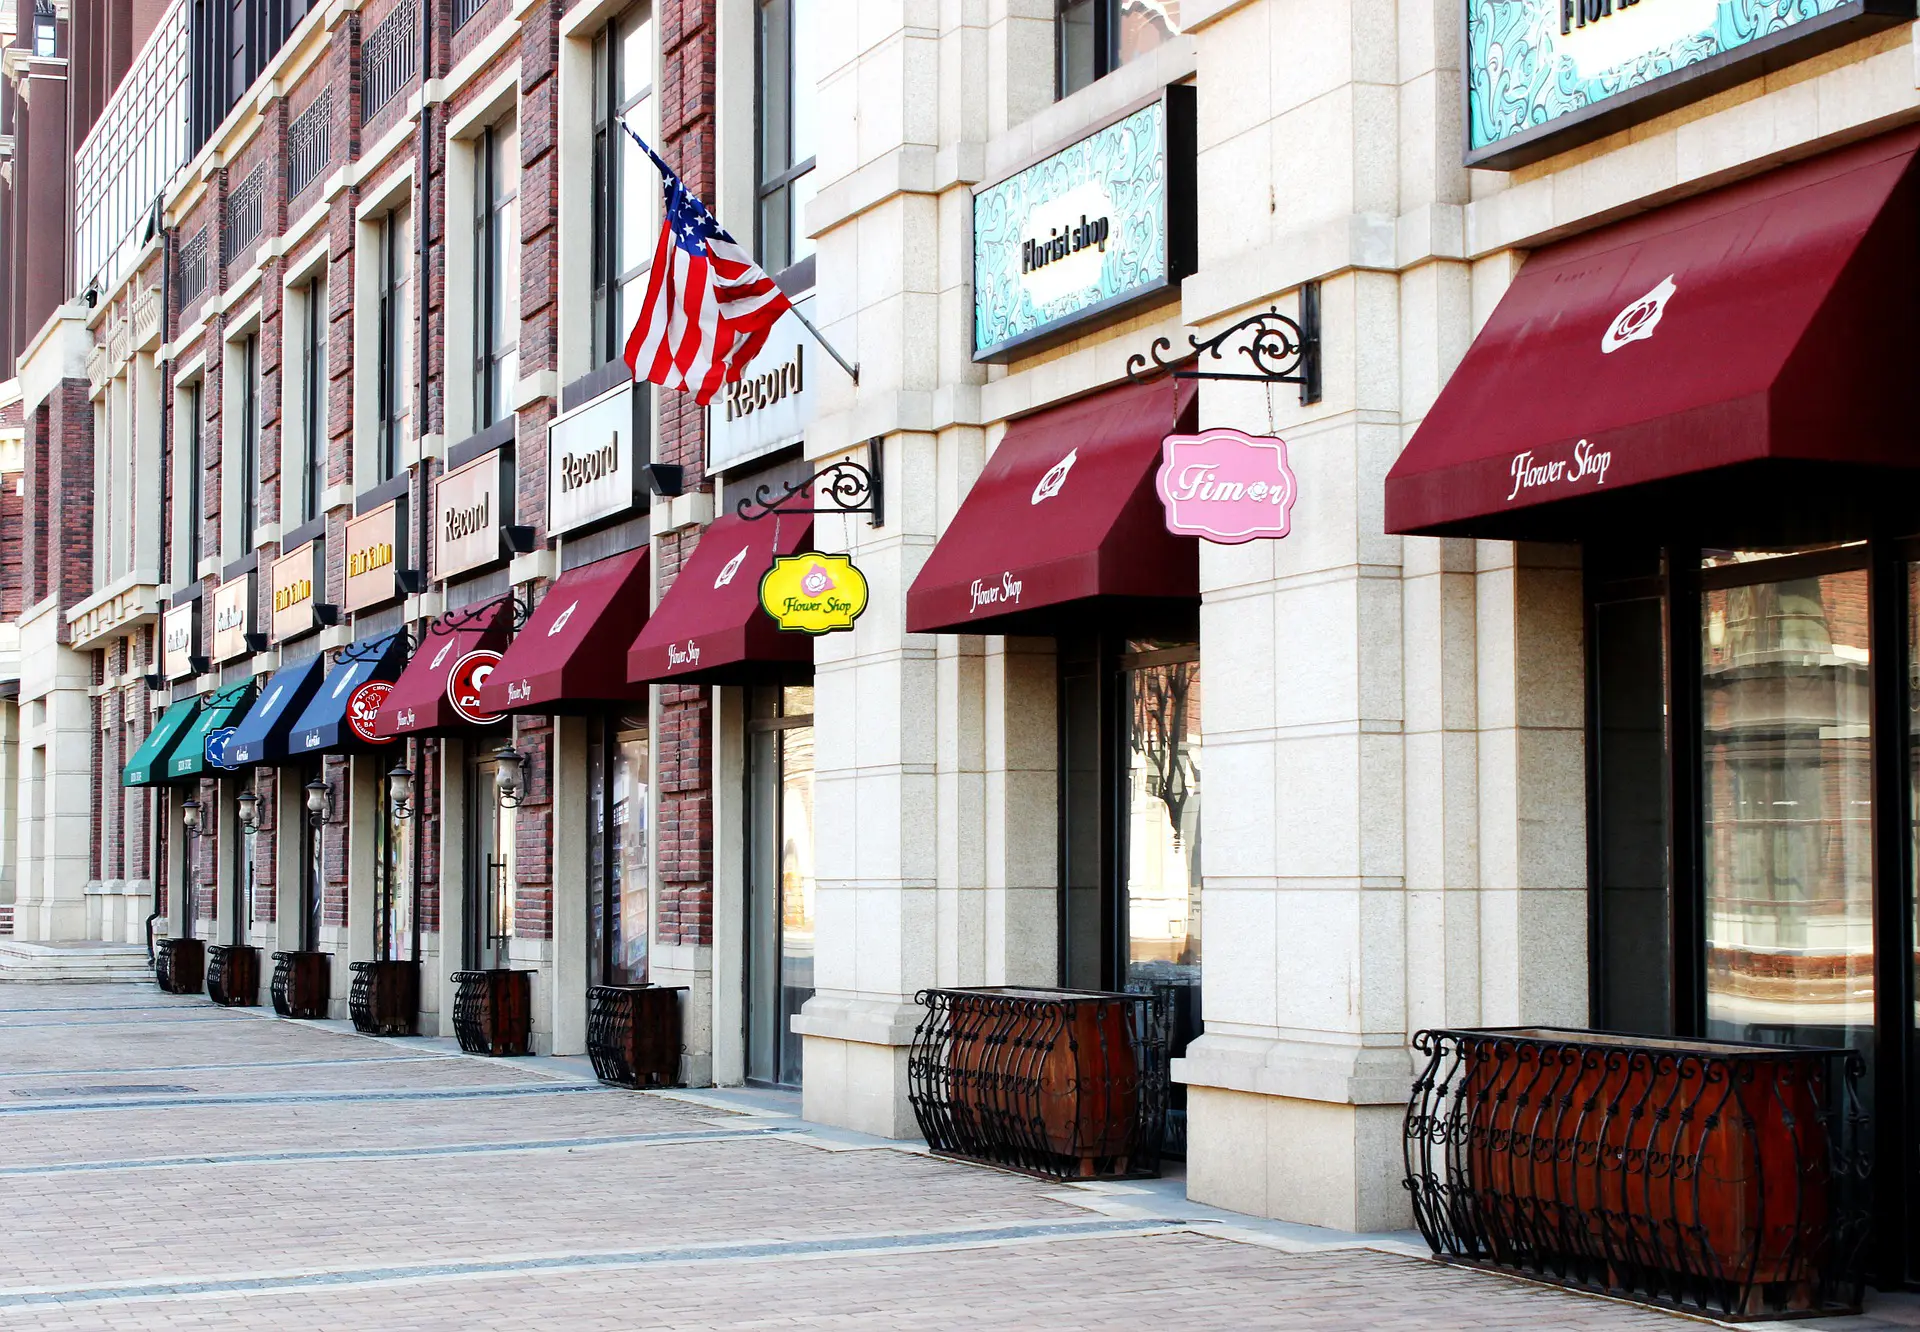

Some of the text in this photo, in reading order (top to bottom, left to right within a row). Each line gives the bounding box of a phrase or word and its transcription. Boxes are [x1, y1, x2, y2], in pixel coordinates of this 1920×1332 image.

[1021, 213, 1109, 275] Florist shop
[723, 343, 804, 423] Record
[561, 430, 619, 493] Record
[1506, 438, 1611, 501] Flower Shop
[444, 490, 490, 543] Record
[782, 596, 852, 616] Flower Shop
[970, 571, 1022, 614] Flower Shop
[667, 639, 700, 670] Flower Shop
[349, 701, 379, 721] Sw
